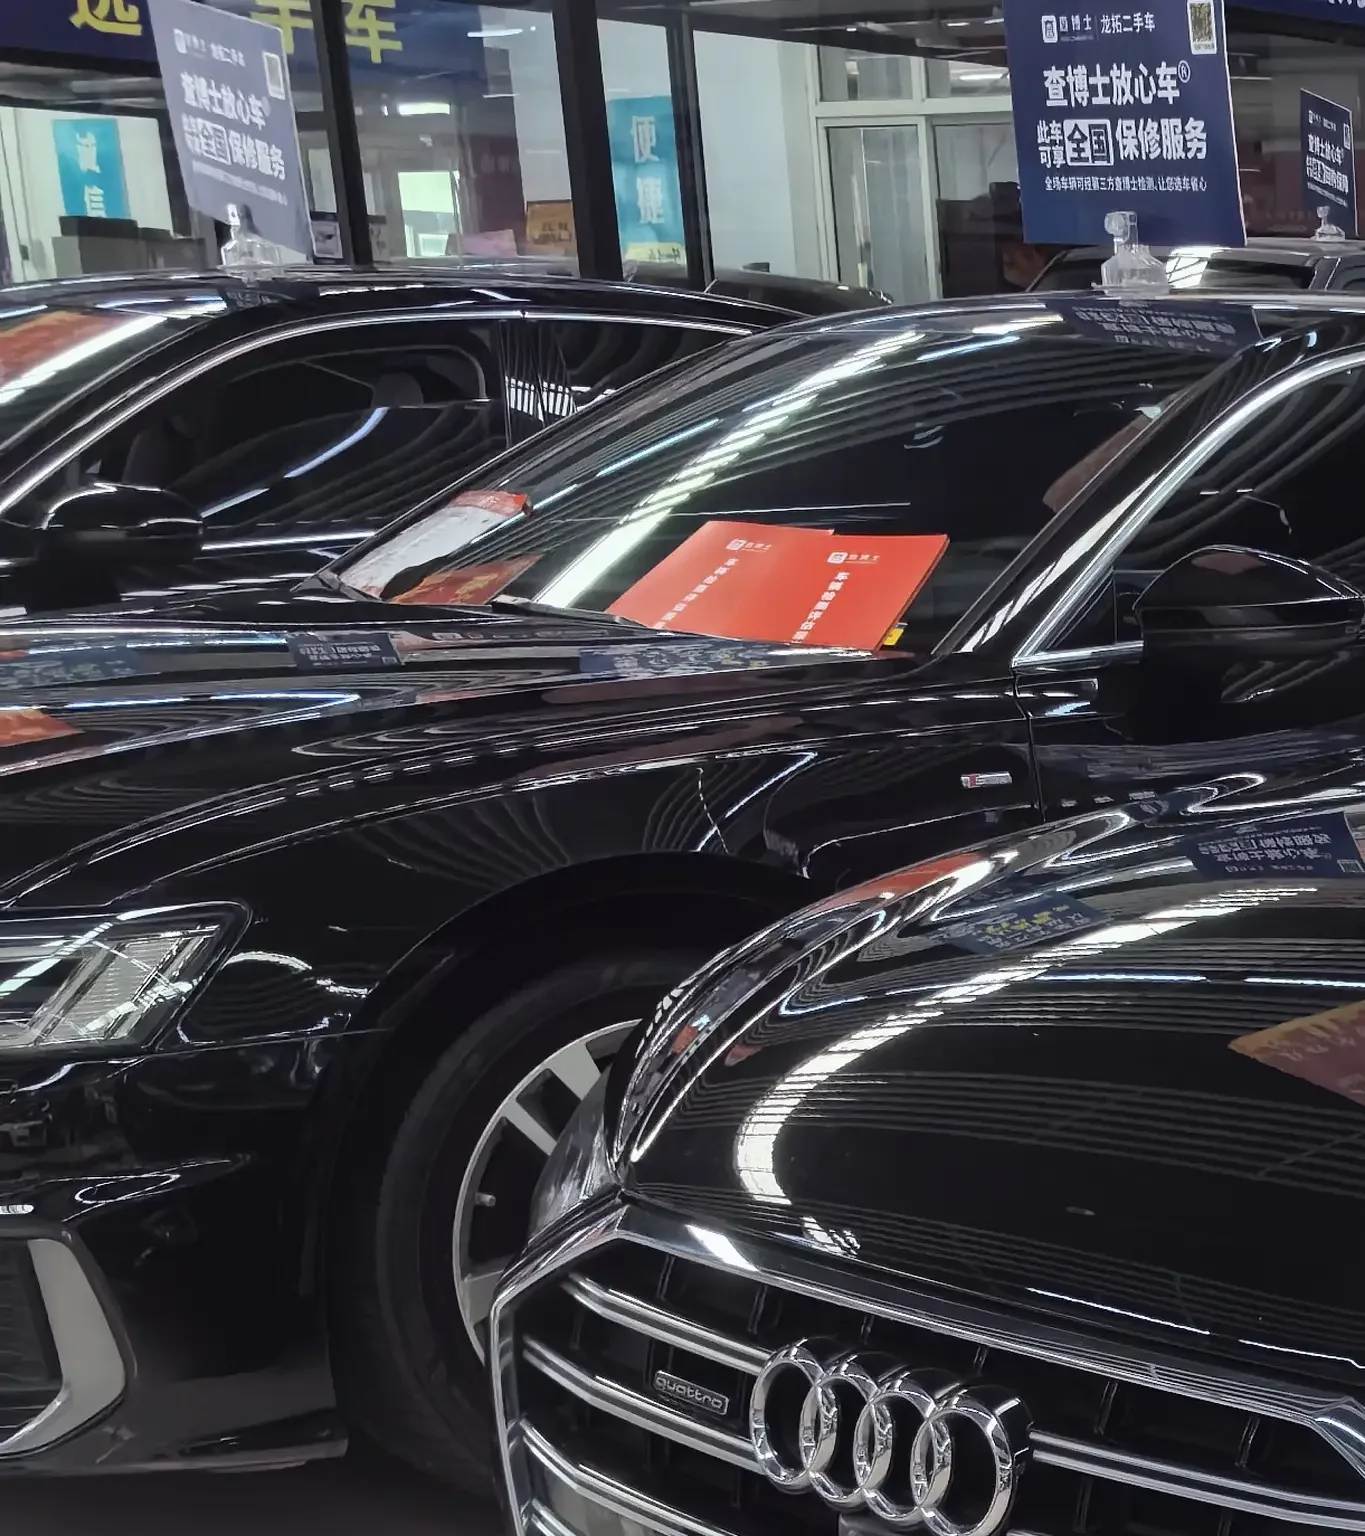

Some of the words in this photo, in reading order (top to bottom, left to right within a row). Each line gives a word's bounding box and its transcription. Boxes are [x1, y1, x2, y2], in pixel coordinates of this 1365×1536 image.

[1101, 12, 1155, 34] 龙拓二手车
[655, 1376, 723, 1409] quattro
